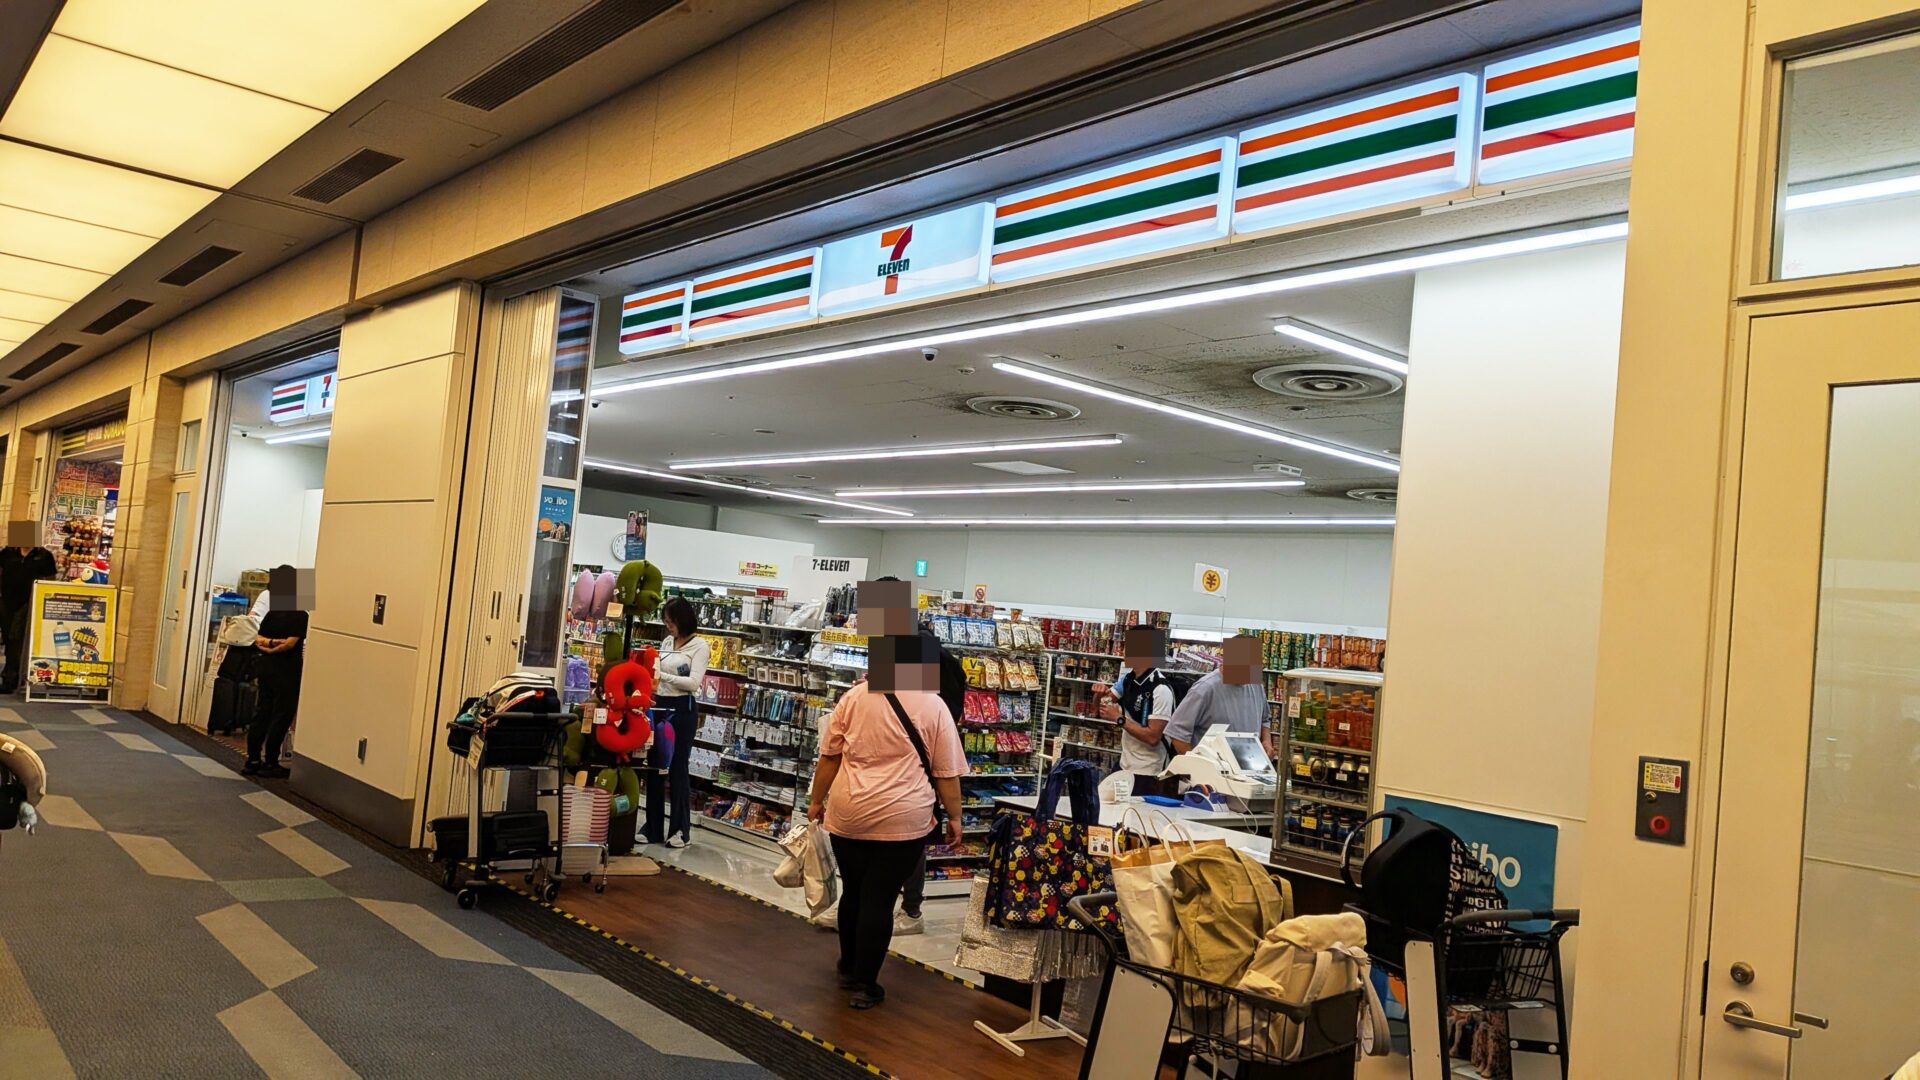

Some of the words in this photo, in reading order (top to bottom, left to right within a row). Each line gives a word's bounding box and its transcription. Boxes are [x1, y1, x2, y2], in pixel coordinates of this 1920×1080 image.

[881, 224, 913, 295] 7
[544, 496, 568, 506] yoibo
[1472, 842, 1521, 887] ibo
